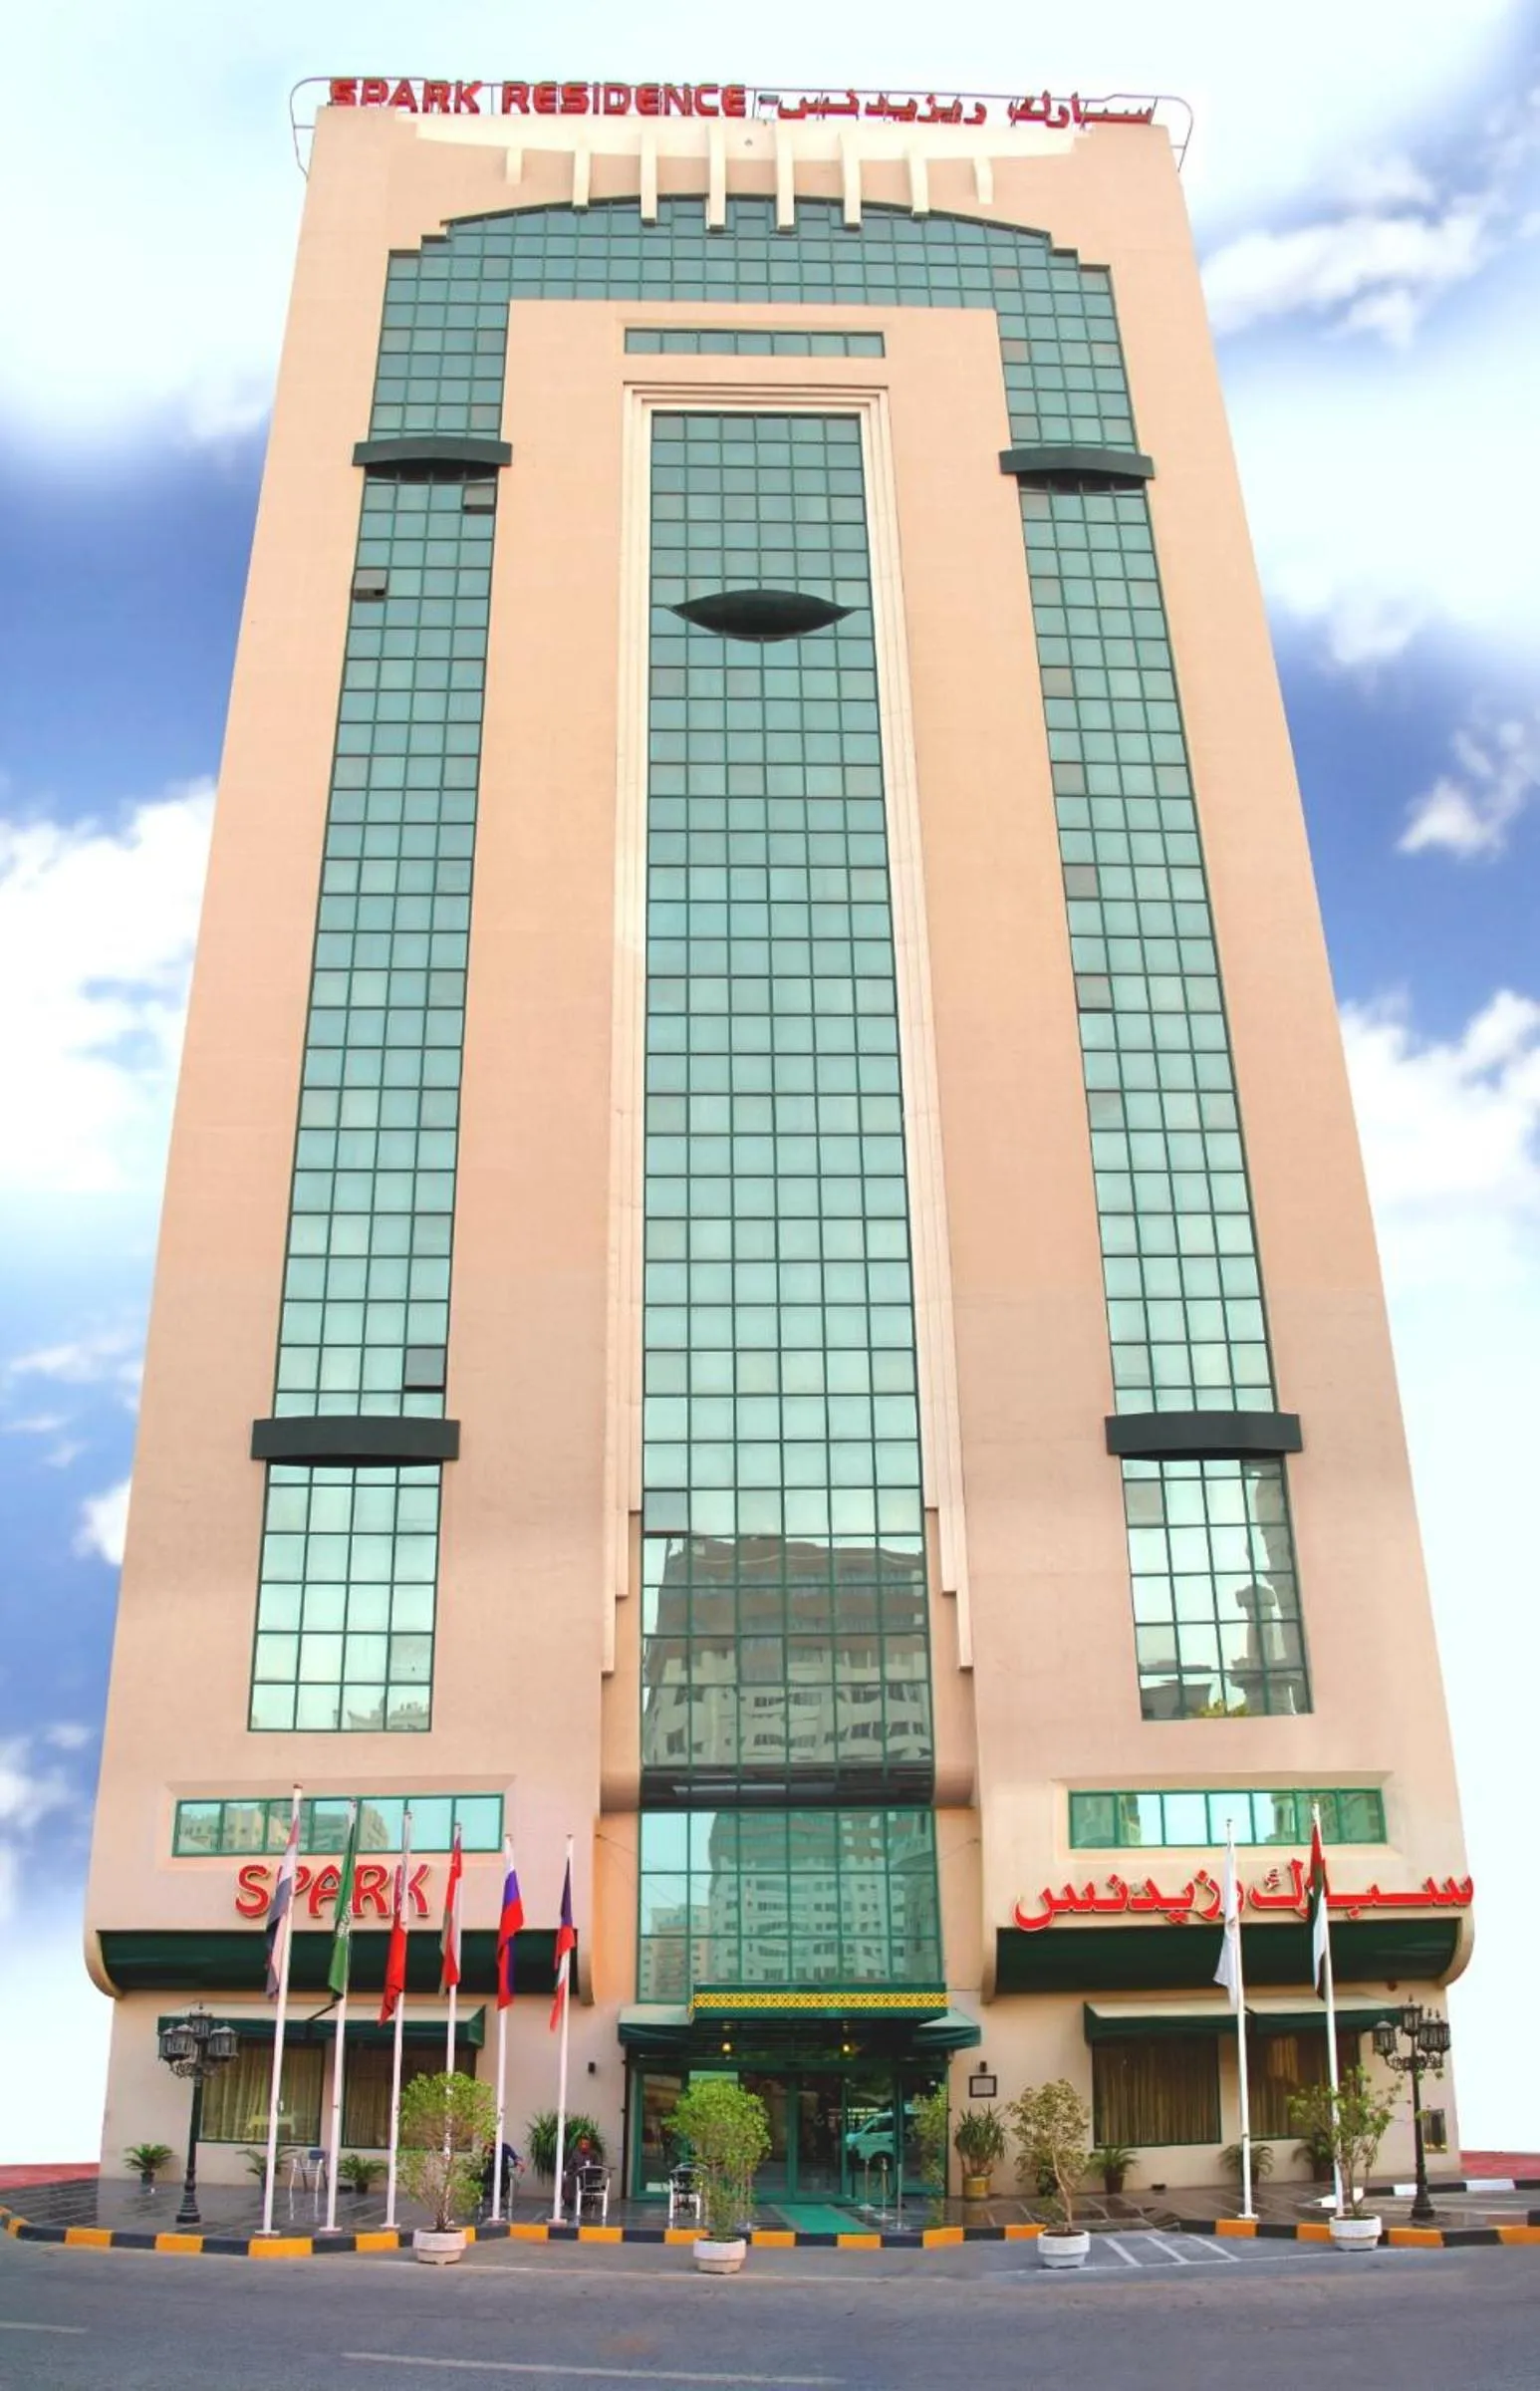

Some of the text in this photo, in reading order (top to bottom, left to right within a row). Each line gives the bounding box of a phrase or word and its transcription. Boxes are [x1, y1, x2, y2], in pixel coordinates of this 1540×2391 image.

[330, 77, 747, 118] SPARK RESIDENCE
[234, 1863, 430, 1918] SPARK
